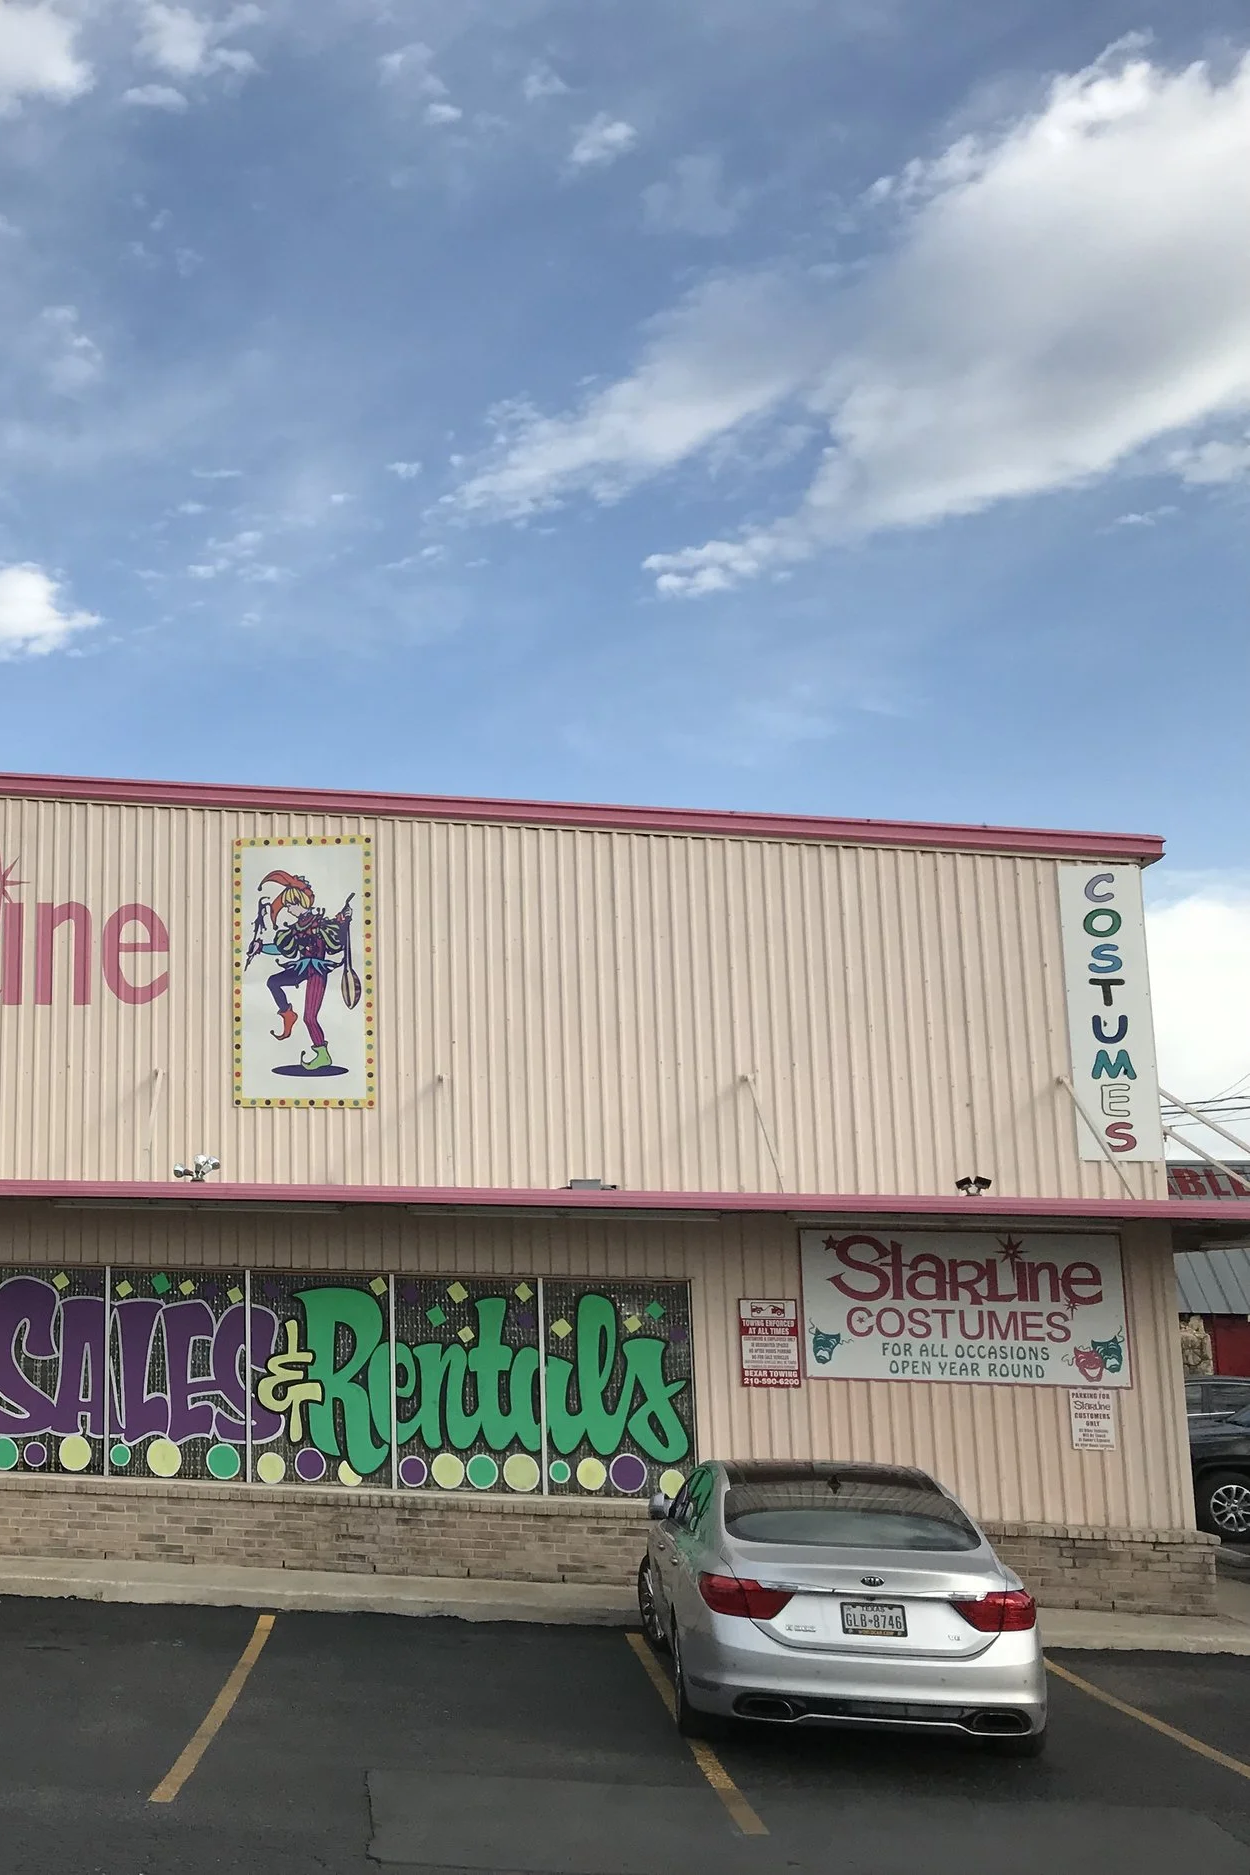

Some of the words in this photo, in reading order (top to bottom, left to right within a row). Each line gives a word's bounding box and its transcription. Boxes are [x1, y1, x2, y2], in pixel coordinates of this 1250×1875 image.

[1083, 872, 1137, 1153] COSTUMES
[748, 1327, 756, 1335] AT
[757, 1327, 770, 1335] ALL
[770, 1327, 790, 1335] TIMES
[765, 1320, 795, 1328] ENFORCED
[846, 1306, 1072, 1343] COSTUMES
[881, 1342, 913, 1357] FOR
[920, 1343, 948, 1358] ALL
[954, 1344, 1050, 1361] OCCASIONS
[889, 1359, 932, 1375] OPEN
[938, 1361, 980, 1377] YEAR
[988, 1362, 1045, 1379] ROUND
[257, 1318, 324, 1443] &
[292, 1286, 690, 1476] Rentals
[743, 1377, 800, 1385] 210-590-6200
